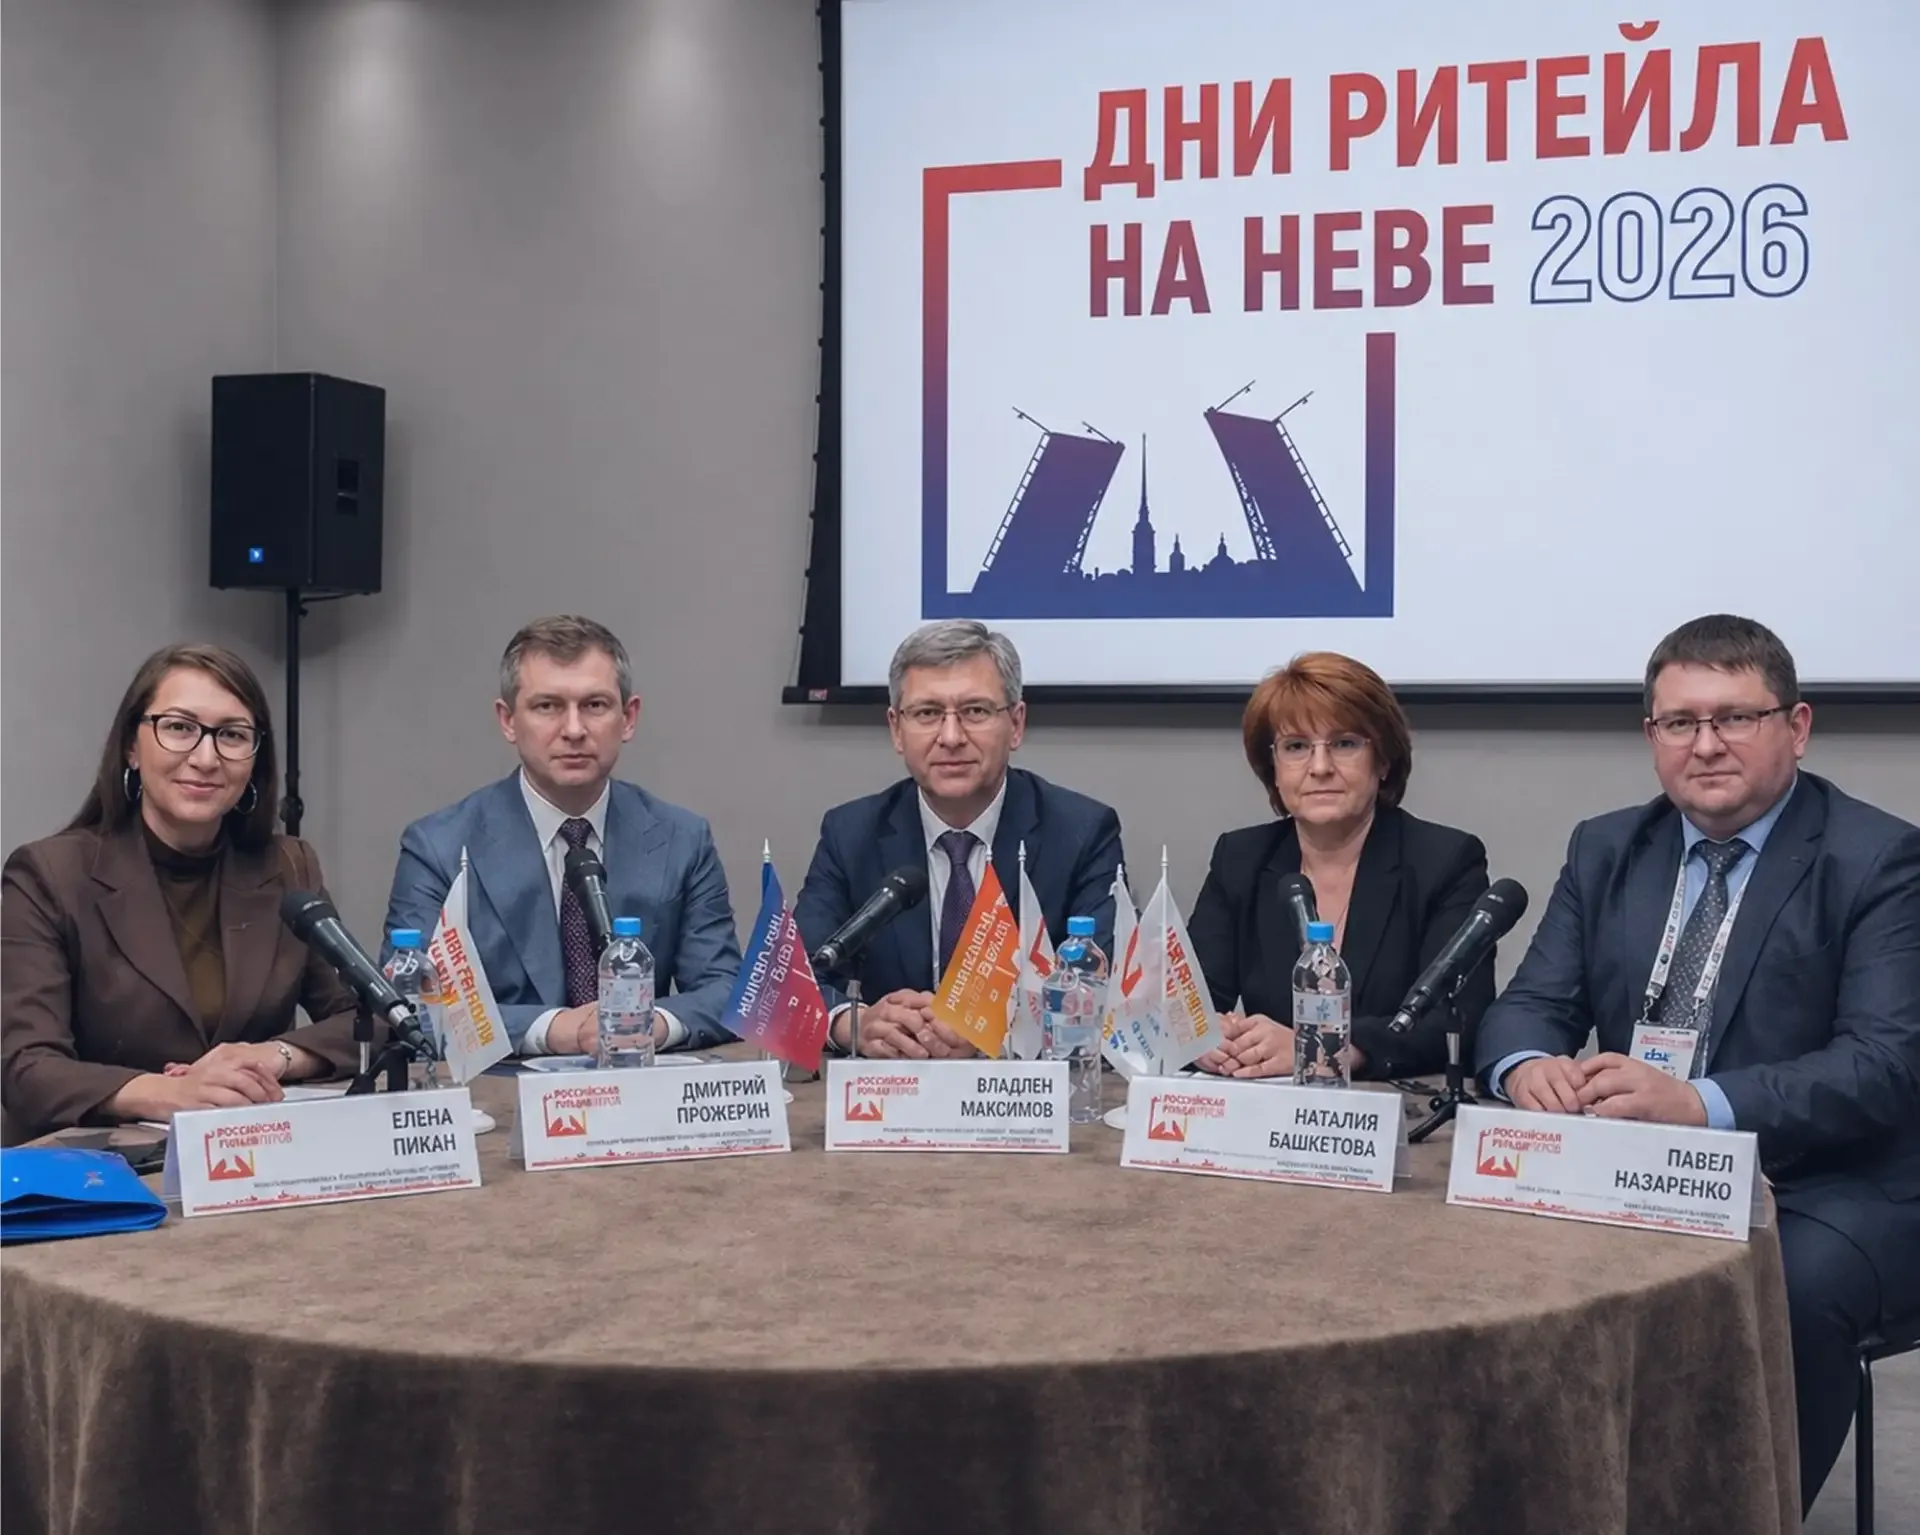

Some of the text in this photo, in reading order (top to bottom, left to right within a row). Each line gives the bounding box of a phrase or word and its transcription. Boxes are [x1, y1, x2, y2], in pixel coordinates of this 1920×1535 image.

[1084, 20, 1848, 200] ДНИ РИТЕЙЛА
[1089, 184, 1810, 317] НА НЕВЕ 2026
[682, 1075, 767, 1103] ДМИТРИЙ
[977, 1077, 1053, 1096] ВЛАДЛЕН
[392, 1108, 453, 1129] ЕЛЕНА
[677, 1102, 770, 1124] ПРОЖЕРИН
[961, 1101, 1053, 1118] МАКСИМОВ
[1295, 1108, 1379, 1132] НАТАЛИЯ
[393, 1134, 456, 1156] ПИКАН
[1269, 1131, 1377, 1157] БАШКЕТОВА
[1667, 1149, 1733, 1173] ПАВЕЛ
[1615, 1171, 1733, 1201] НАЗАРЕНКО
